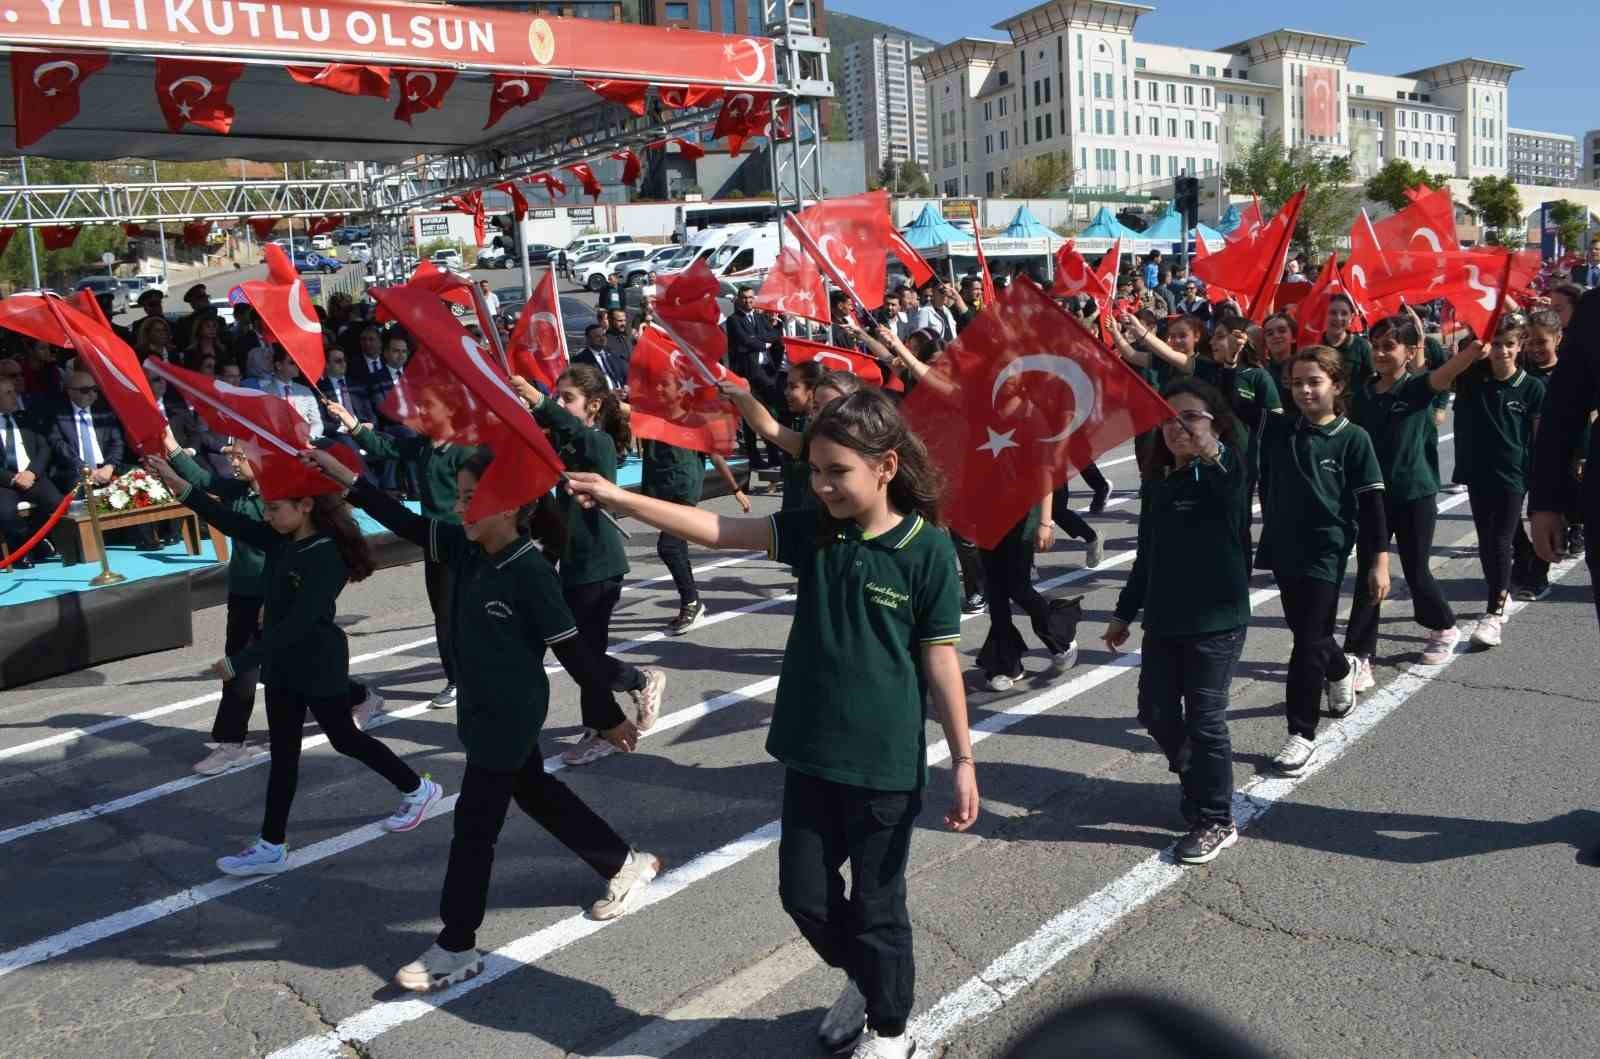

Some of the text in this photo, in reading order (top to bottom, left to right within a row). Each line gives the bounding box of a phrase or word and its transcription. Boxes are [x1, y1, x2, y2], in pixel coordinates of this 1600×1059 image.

[40, 0, 148, 31] YILI
[164, 0, 331, 42] KUTLU
[346, 10, 496, 53] OLSUN
